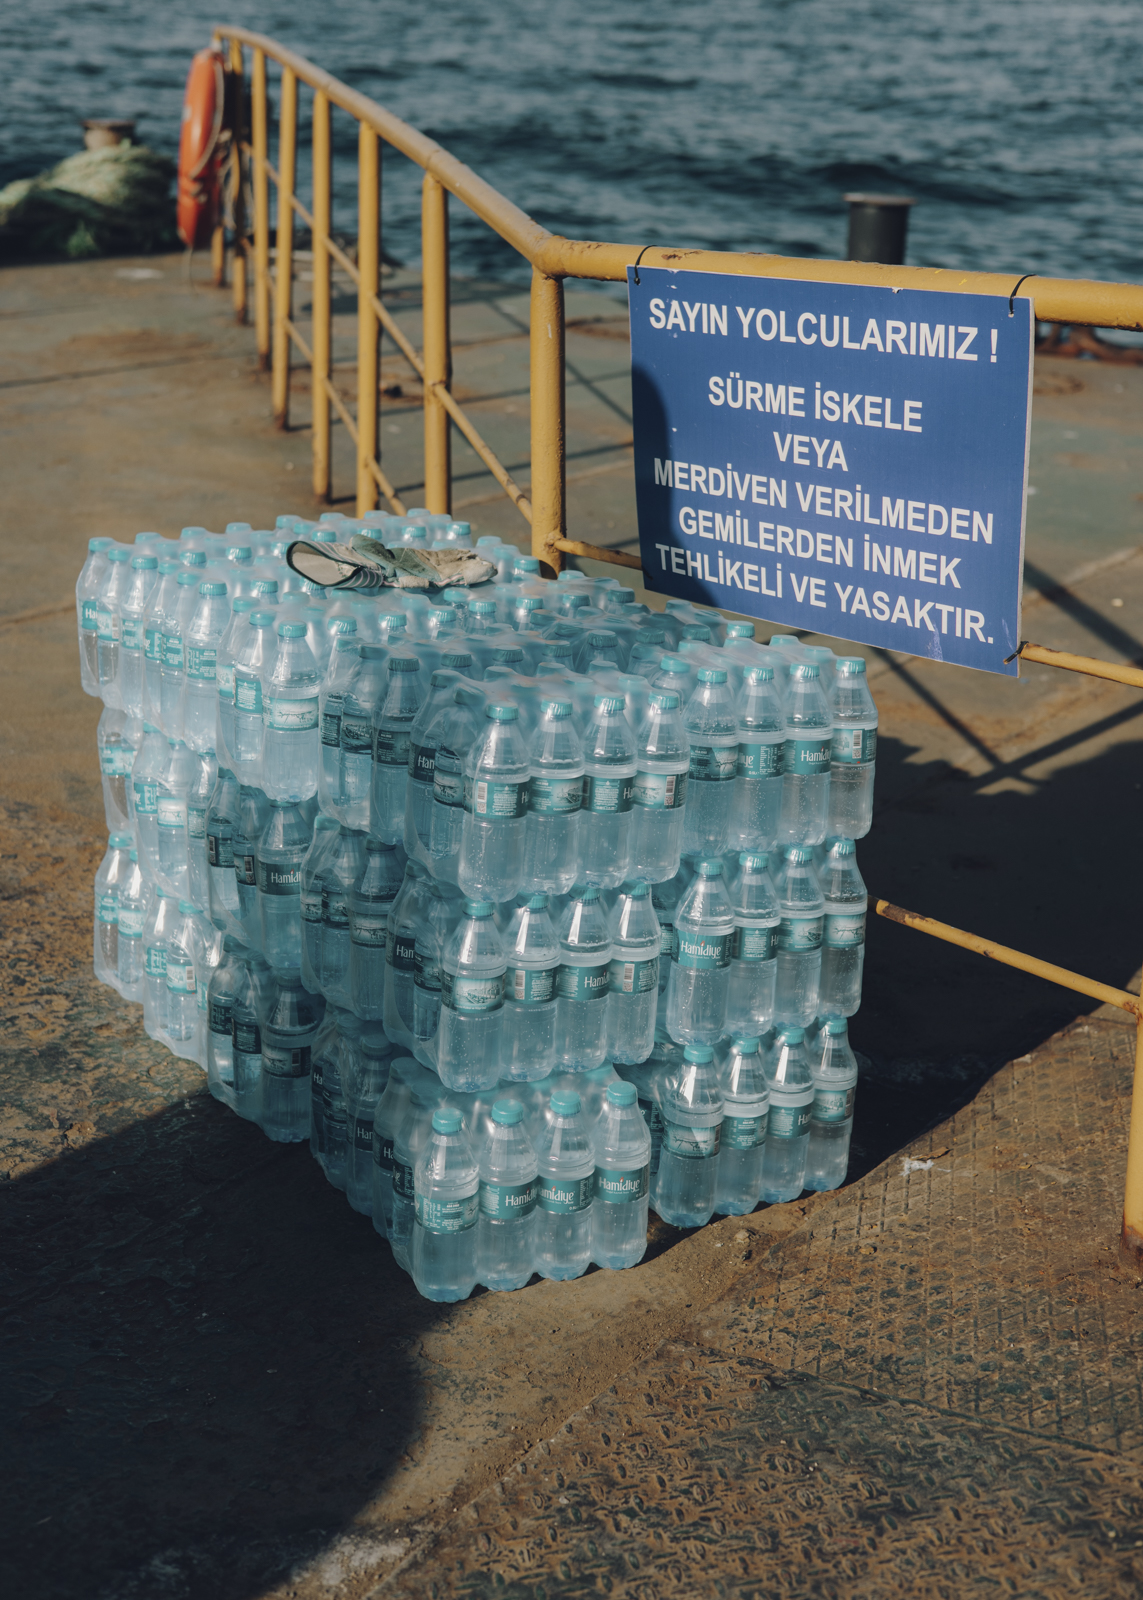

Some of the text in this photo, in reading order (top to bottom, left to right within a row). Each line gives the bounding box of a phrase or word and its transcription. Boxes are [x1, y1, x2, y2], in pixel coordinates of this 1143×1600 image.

[649, 298, 998, 363] SAYIN YOLCULARIMIZ !
[708, 371, 923, 433] SÜRME İSKELE
[773, 431, 849, 472] VEYA
[654, 458, 994, 545] MERDİVEN VERİLMEDEN
[679, 505, 962, 589] GEMİLERDEN İNMEK
[655, 543, 994, 644] TEHLİKELİ VE YASAKTIR.
[270, 870, 301, 884] Hamidi
[681, 940, 722, 960] Hamidiye
[540, 1186, 575, 1205] amidiye
[599, 1177, 641, 1193] Hamidiye
